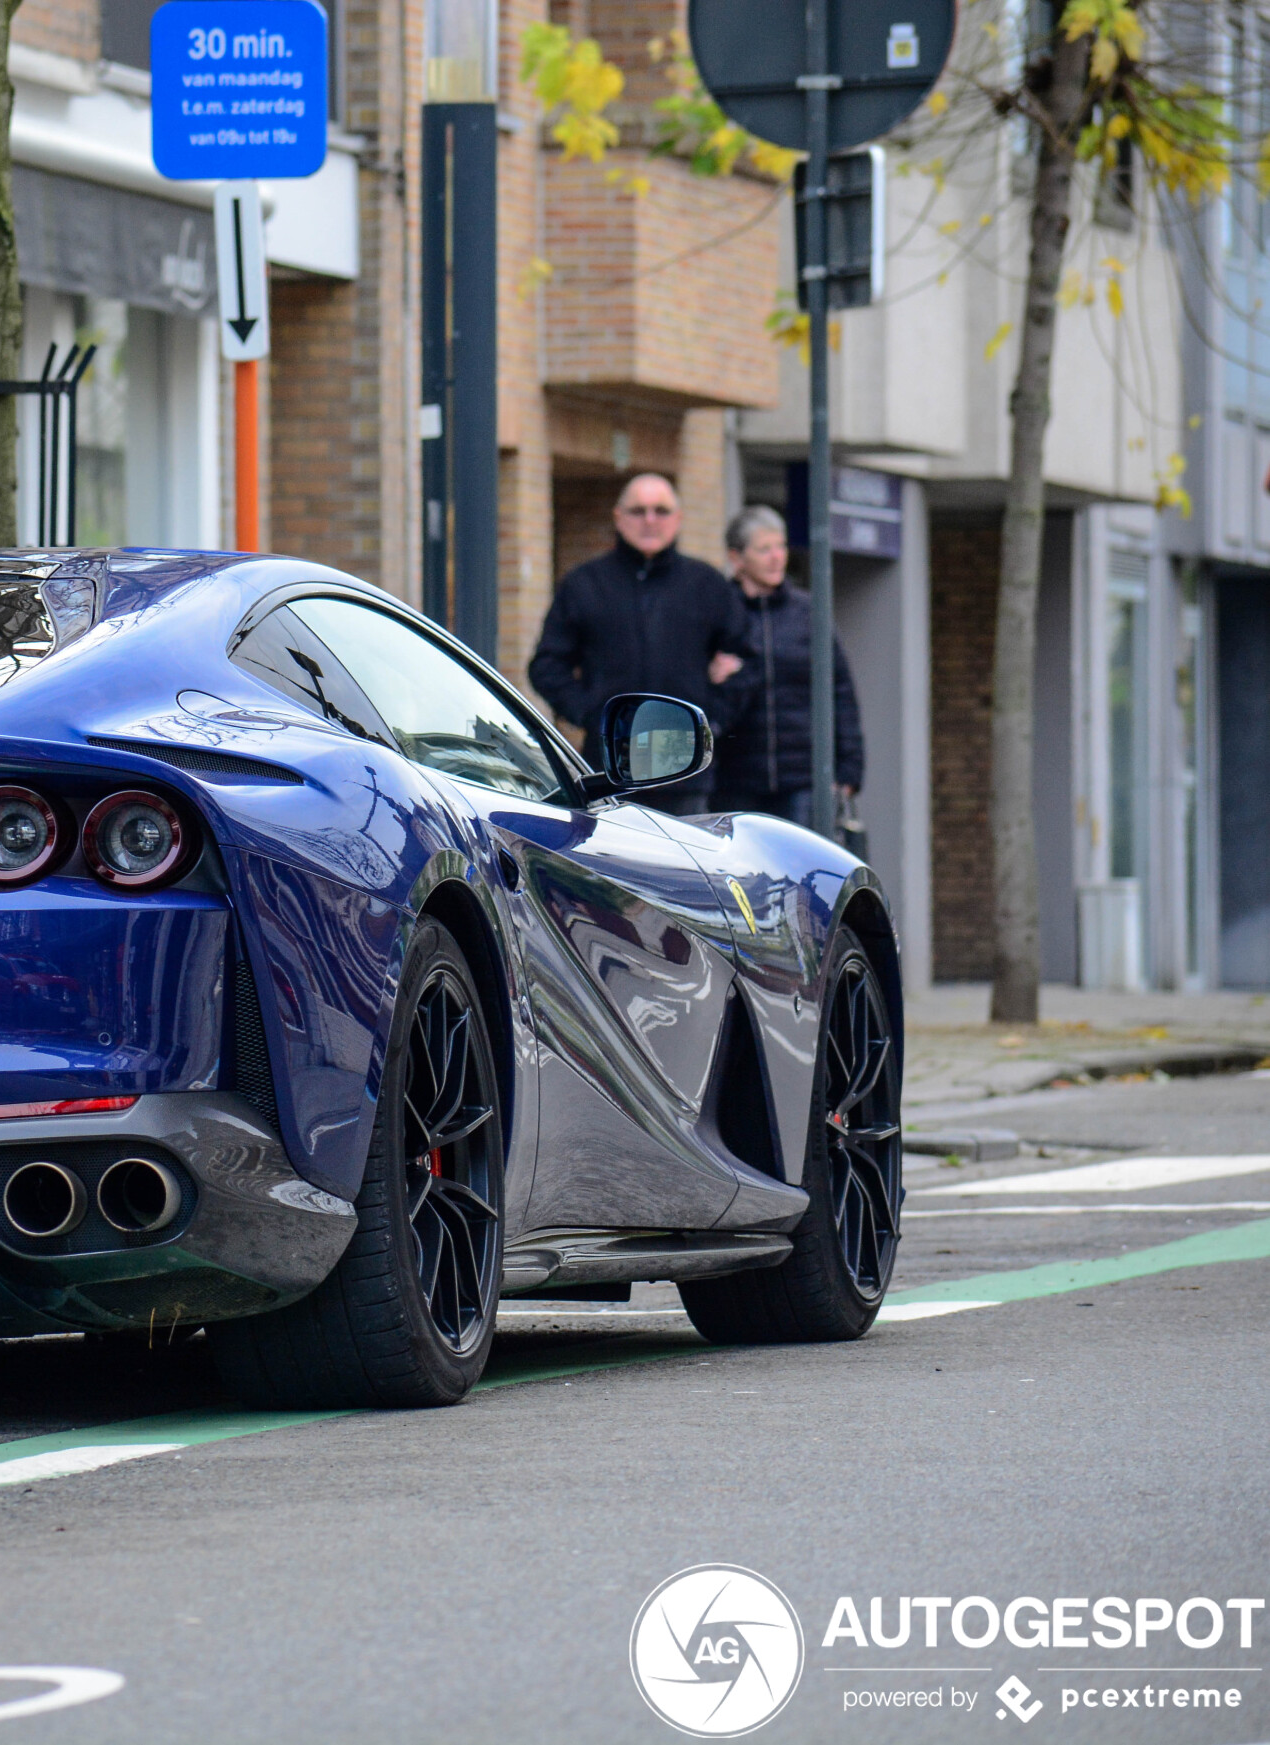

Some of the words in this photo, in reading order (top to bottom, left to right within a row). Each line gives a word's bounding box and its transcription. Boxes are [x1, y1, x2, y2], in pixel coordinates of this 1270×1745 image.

[188, 27, 226, 60] 30
[232, 27, 293, 59] min.
[182, 73, 215, 87] van
[218, 69, 303, 89] maandag
[182, 99, 226, 115] t.e.m.
[231, 98, 305, 117] zaterdag
[189, 132, 215, 145] van
[217, 129, 246, 145] 09u
[249, 130, 269, 145] tot
[273, 128, 297, 144] 19u
